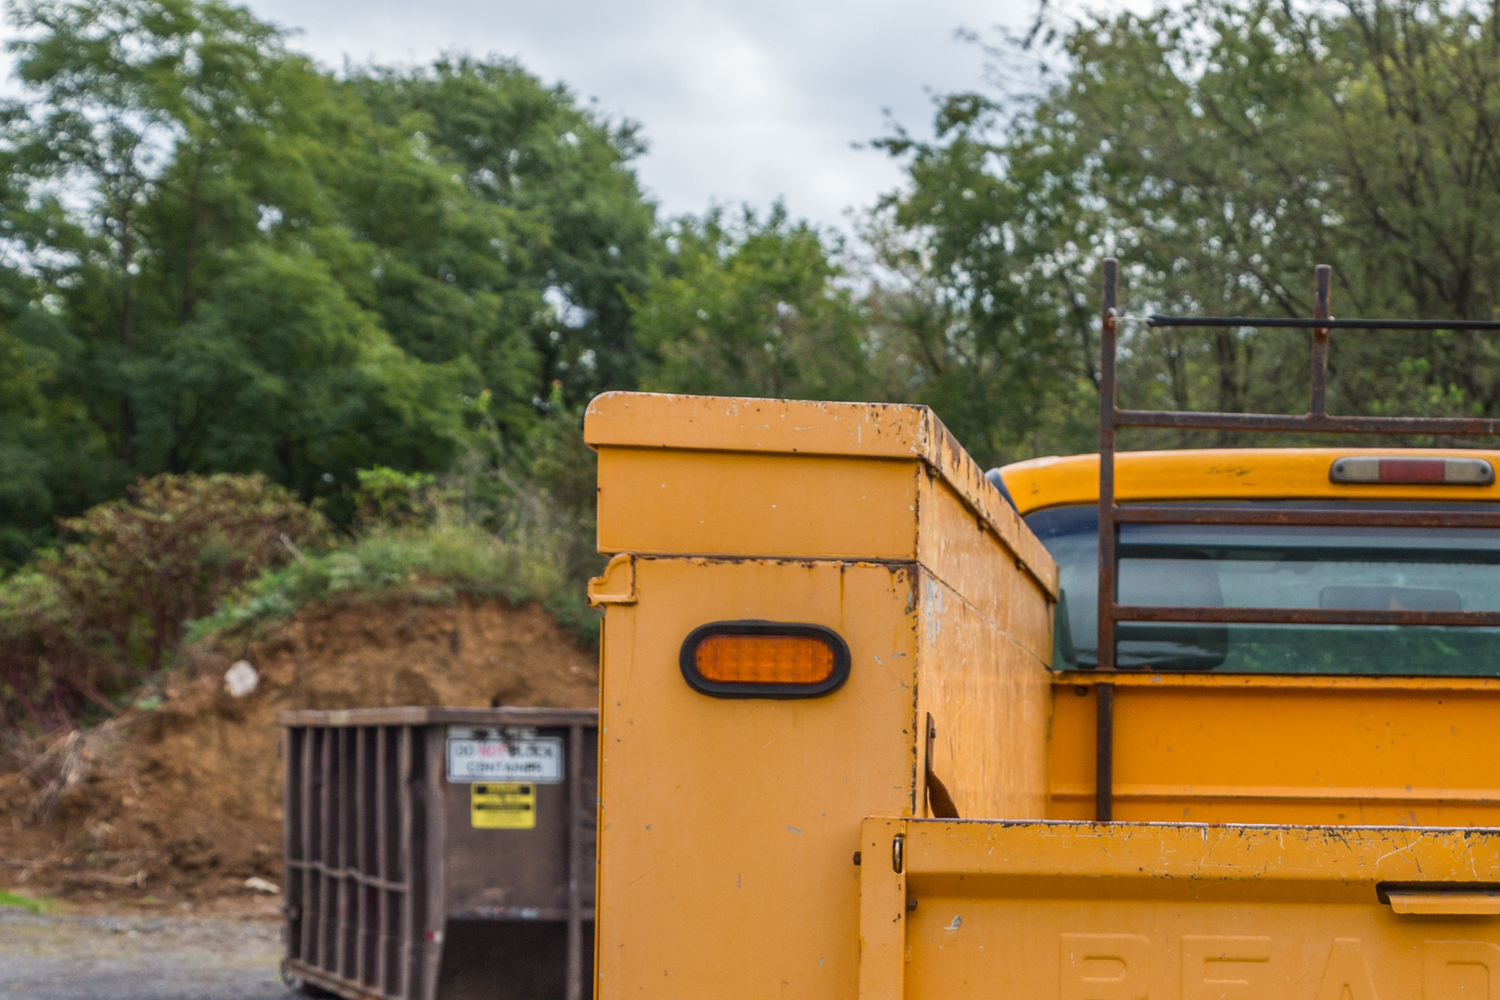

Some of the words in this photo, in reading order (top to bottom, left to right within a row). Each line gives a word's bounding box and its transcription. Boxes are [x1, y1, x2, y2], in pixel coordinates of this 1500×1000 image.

[454, 744, 474, 756] DO
[478, 743, 507, 757] NOT
[509, 743, 552, 757] BLOCK
[466, 760, 541, 773] CONTAINER
